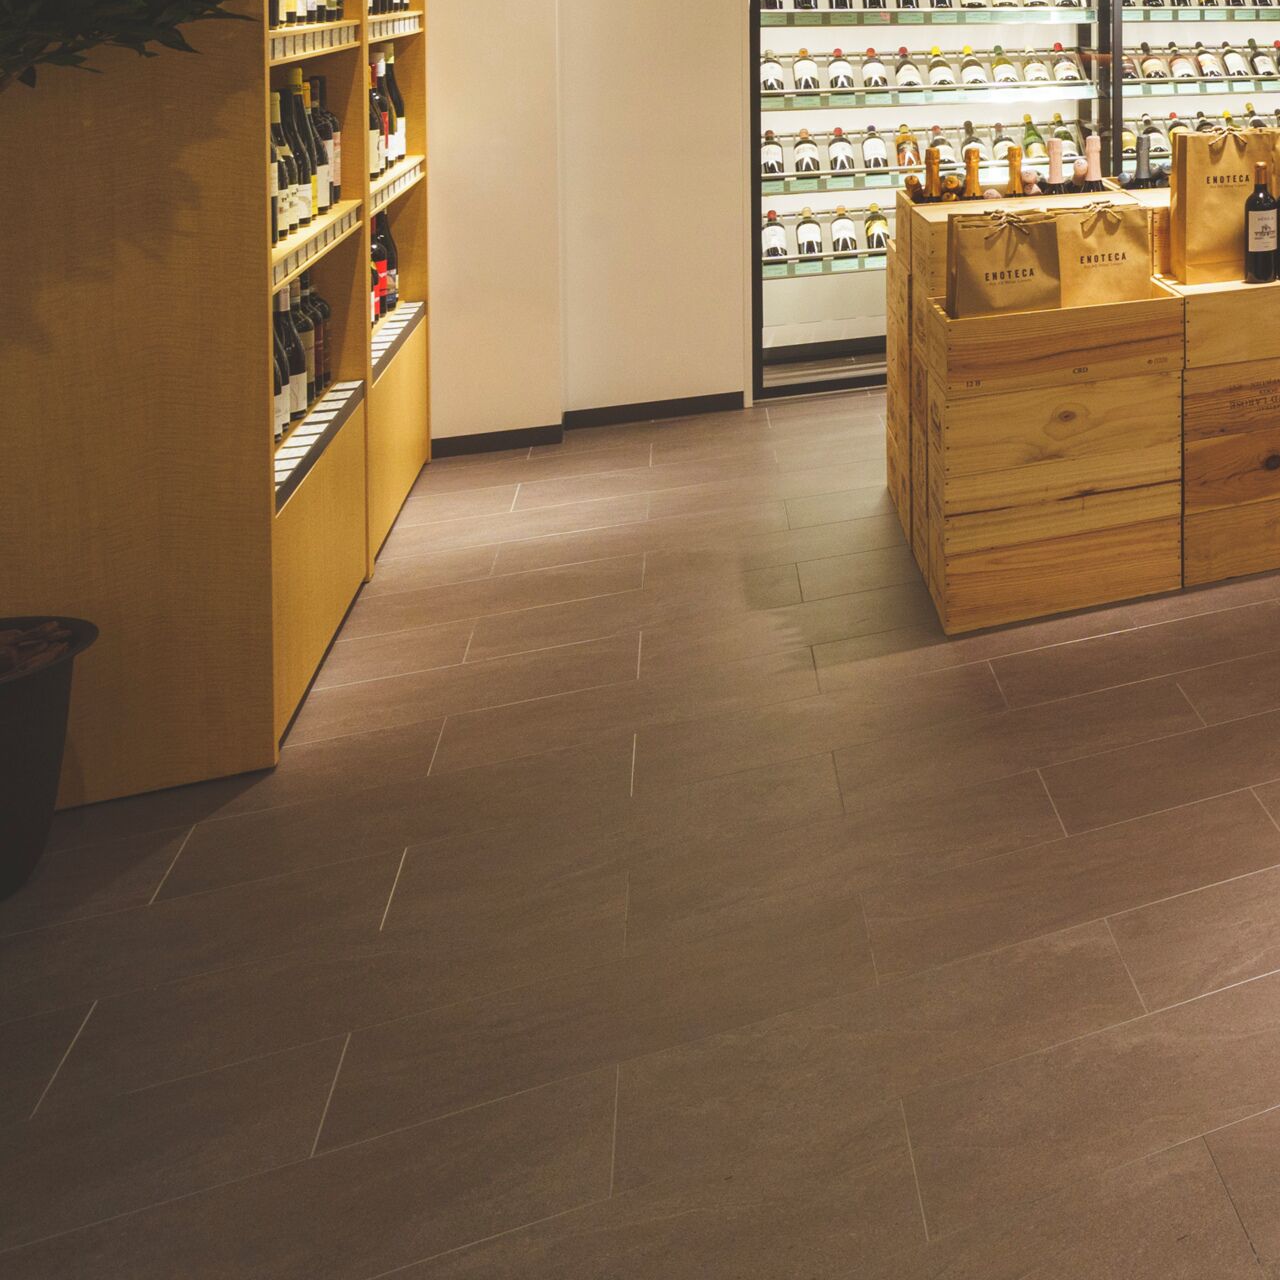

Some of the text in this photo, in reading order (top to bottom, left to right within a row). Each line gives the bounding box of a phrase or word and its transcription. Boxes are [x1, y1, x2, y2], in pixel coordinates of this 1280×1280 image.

[1206, 174, 1250, 185] ENOTECA
[1080, 252, 1127, 264] ENOTECA
[985, 268, 1035, 282] ENOTECA
